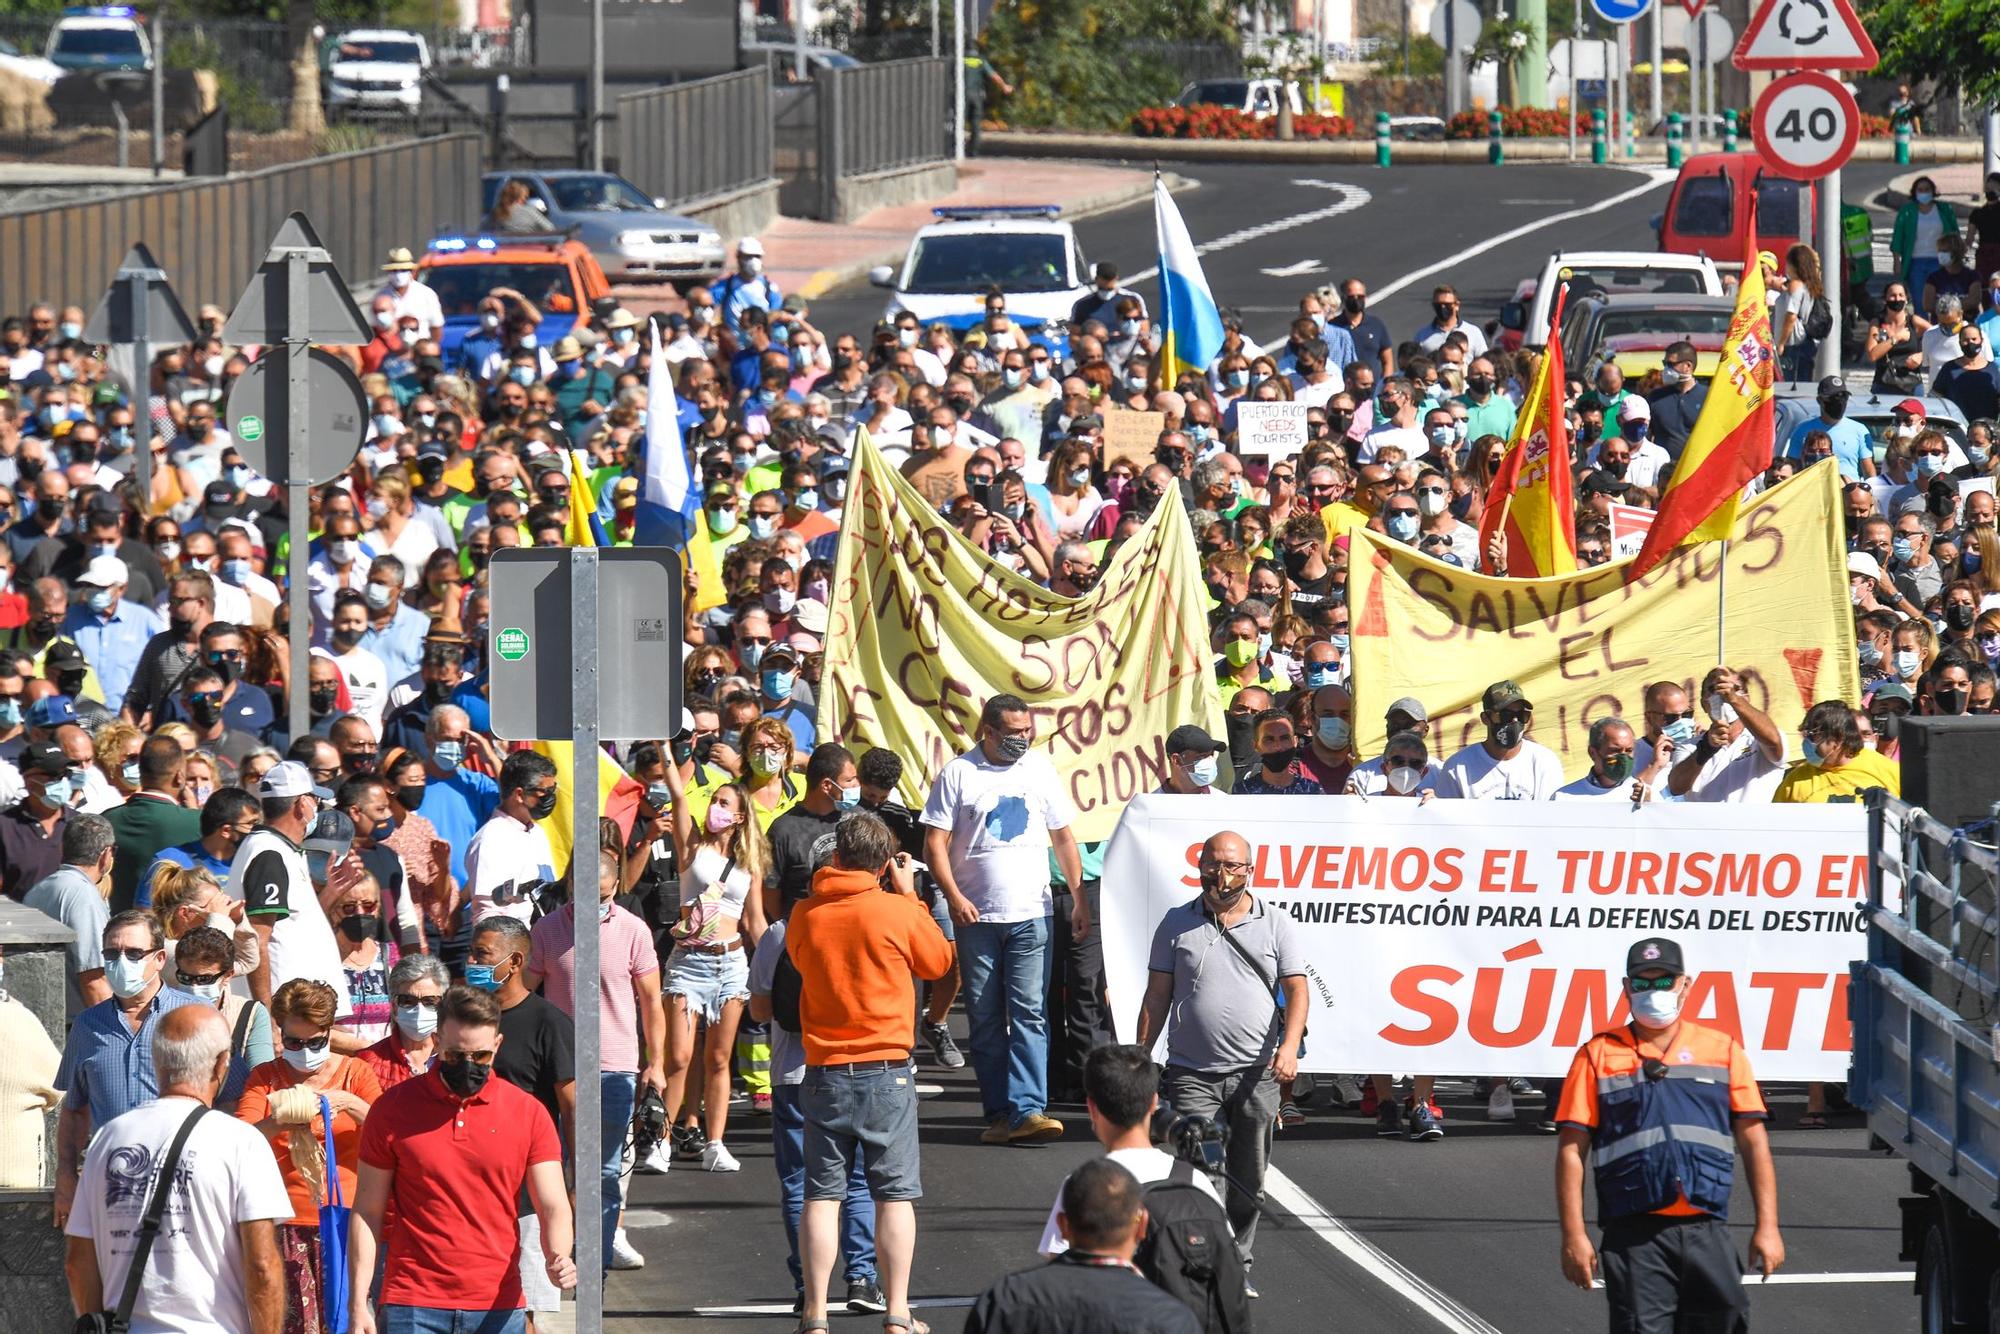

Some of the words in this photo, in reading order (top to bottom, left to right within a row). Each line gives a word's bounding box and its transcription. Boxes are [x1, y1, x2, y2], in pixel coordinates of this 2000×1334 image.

[1775, 107, 1837, 142] 40
[1241, 405, 1279, 418] PUERTO
[1282, 405, 1306, 416] RICO
[1259, 419, 1296, 432] NEEDS
[1251, 433, 1302, 445] TOURISTS
[1558, 627, 1650, 680] EL
[898, 652, 1132, 755] CETROS
[1180, 842, 1465, 892] SLVEMOS
[1479, 849, 1539, 893] EL
[1557, 850, 1802, 898] TURISMO
[264, 883, 280, 905] 2
[1476, 905, 1542, 928] PARA
[1550, 906, 1580, 928] LA
[1588, 907, 1700, 930] DEFENSA
[1708, 909, 1755, 931] DEL
[1313, 976, 1335, 1009] MOGÁN
